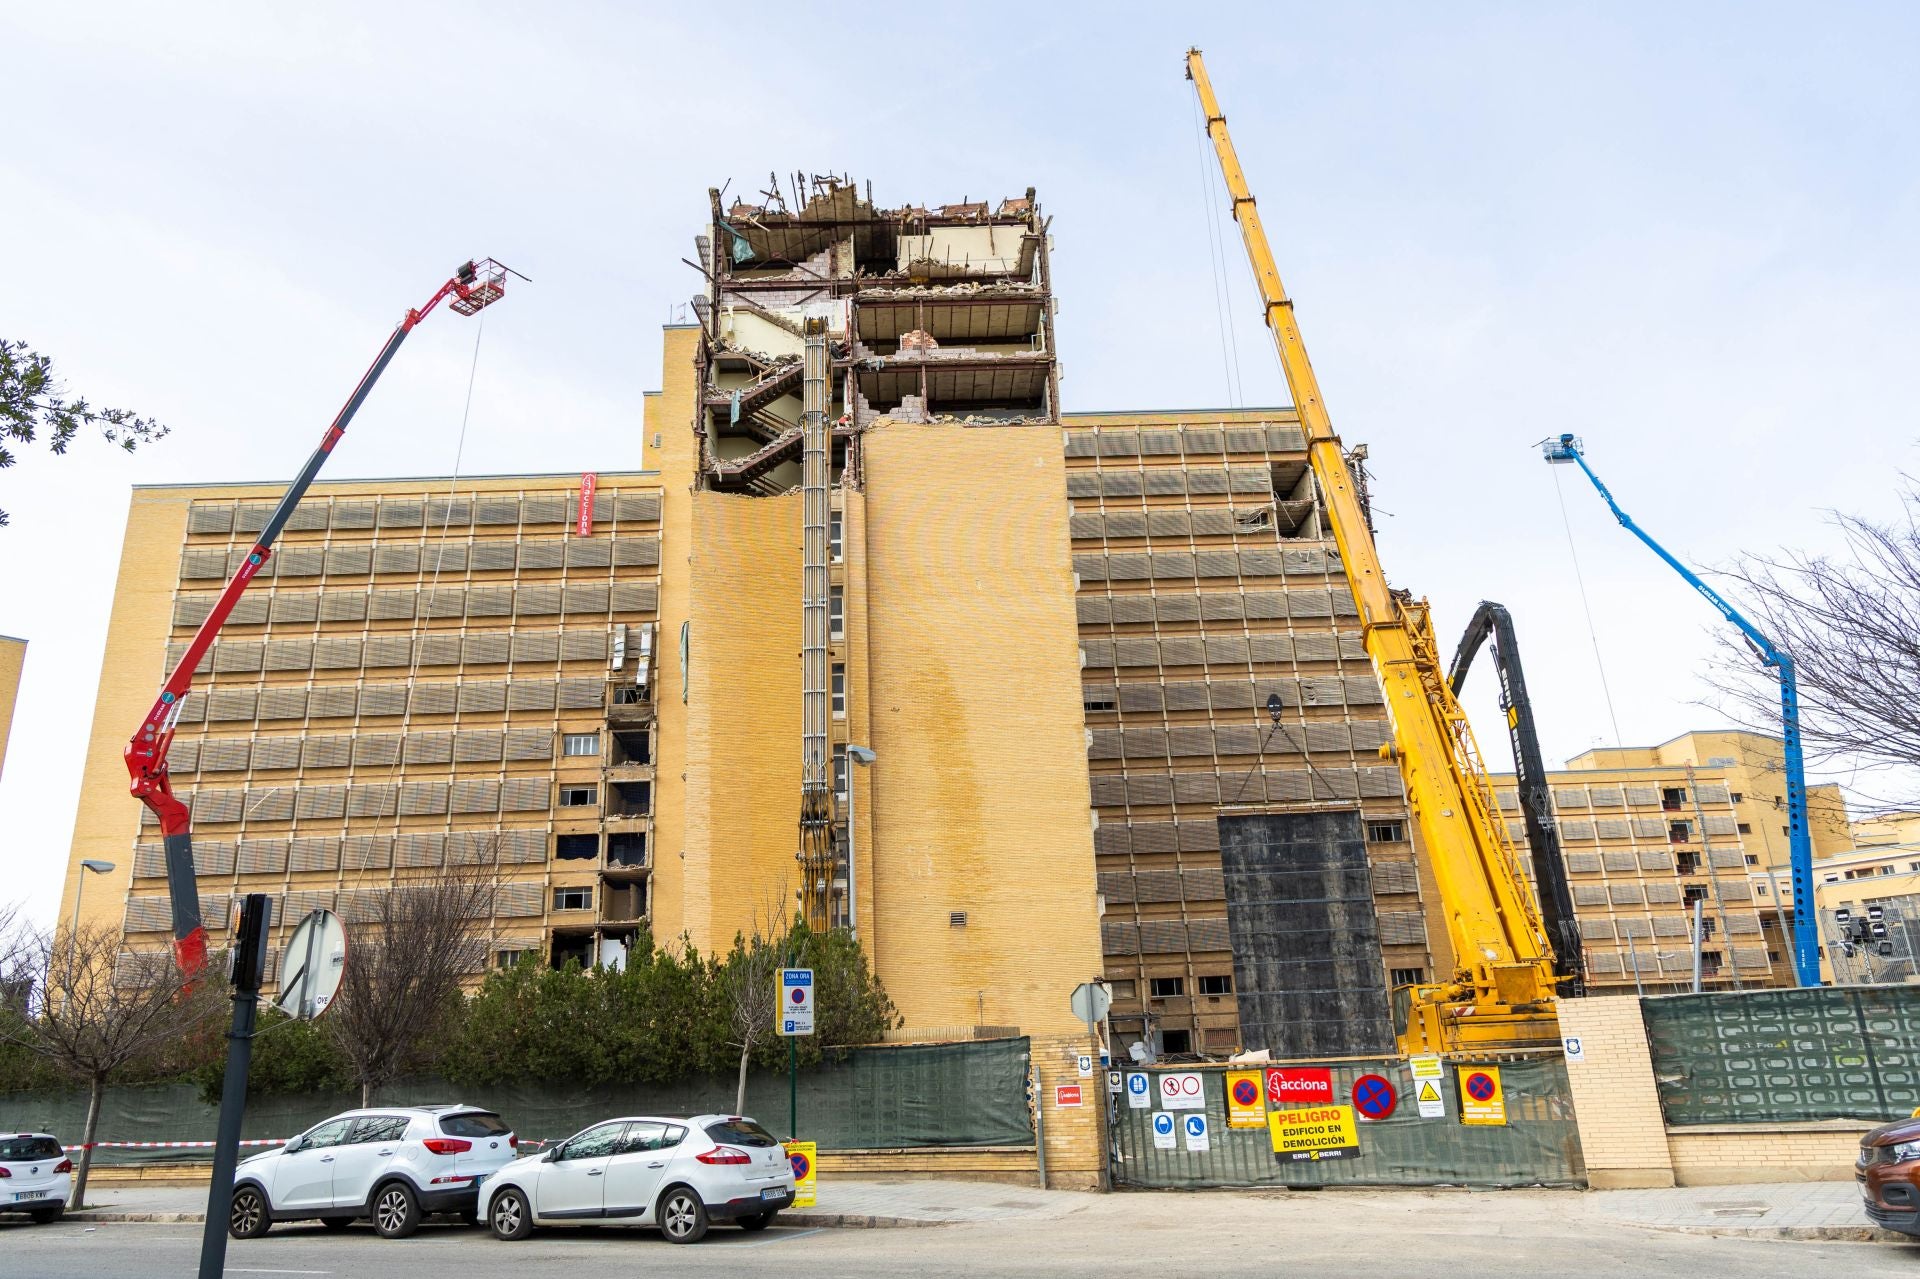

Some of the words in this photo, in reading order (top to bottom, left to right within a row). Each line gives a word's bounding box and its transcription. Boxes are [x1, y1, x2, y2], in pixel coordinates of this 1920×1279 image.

[581, 489, 590, 535] acciona
[1280, 1077, 1328, 1091] acciona
[1278, 1109, 1341, 1125] PELIGRO
[1282, 1126, 1325, 1137] EDIFICIO
[1327, 1124, 1342, 1133] EN
[1282, 1134, 1346, 1148] DEMOLICIÓN
[1292, 1152, 1310, 1160] ERRI
[1318, 1150, 1342, 1158] BERRI
